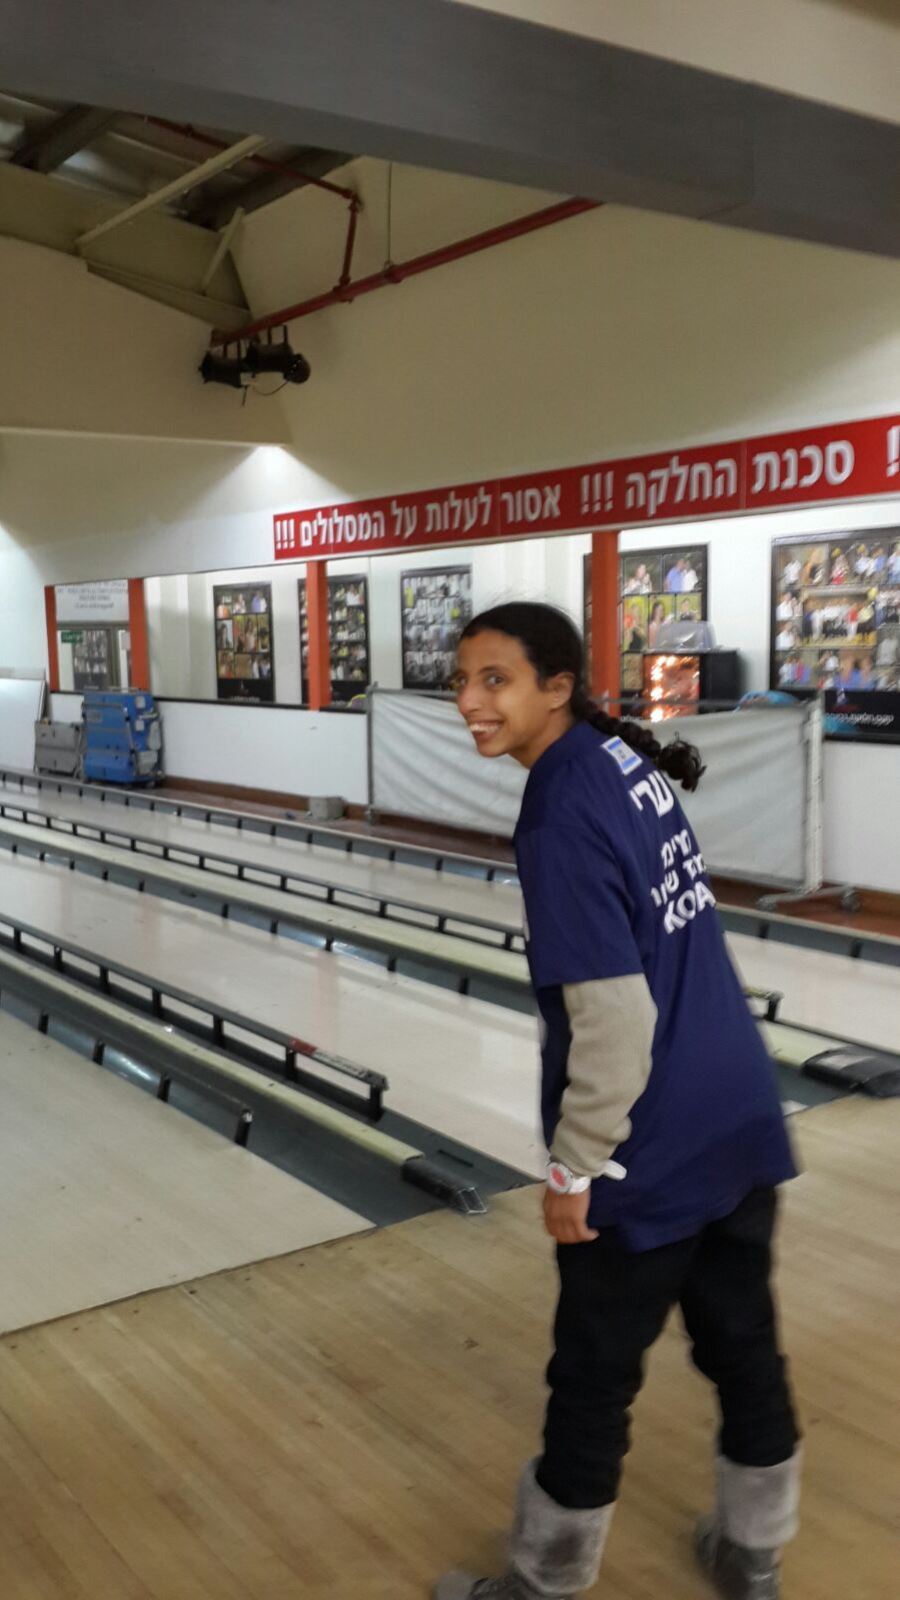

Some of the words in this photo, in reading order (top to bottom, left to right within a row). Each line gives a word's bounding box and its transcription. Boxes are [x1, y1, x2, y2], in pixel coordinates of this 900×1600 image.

[625, 456, 738, 516] החלקה
[751, 440, 855, 494] סכנת
[425, 486, 493, 532] לעלות
[500, 484, 562, 523] אסור
[580, 471, 614, 514] !!!
[275, 518, 296, 550] !!!
[300, 509, 386, 548] המסלולים
[390, 500, 417, 538] על
